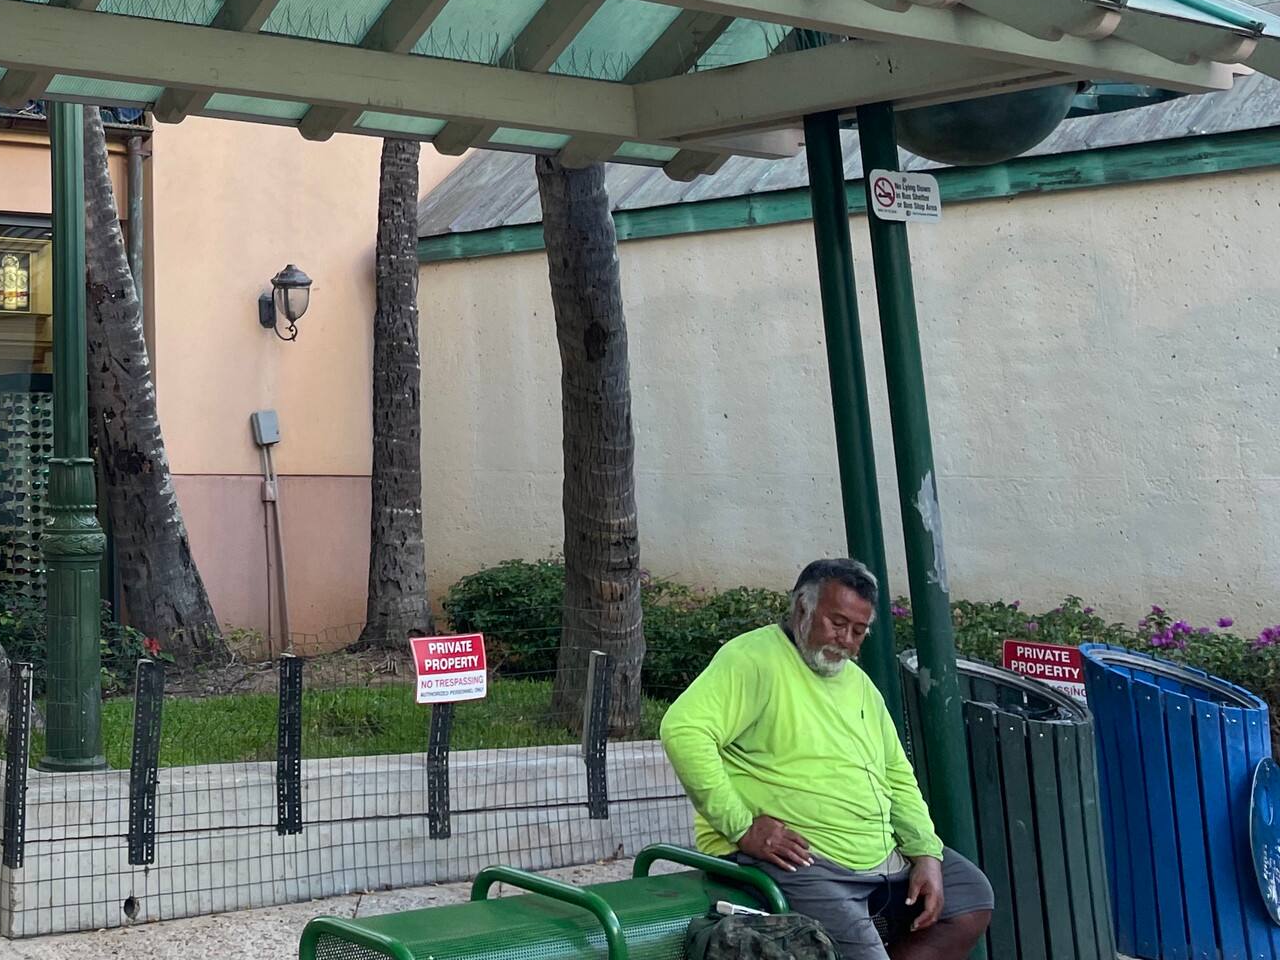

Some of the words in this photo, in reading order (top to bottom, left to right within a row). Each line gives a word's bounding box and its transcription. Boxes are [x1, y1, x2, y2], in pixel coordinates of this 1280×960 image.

[428, 640, 473, 655] PRIVATE
[1016, 645, 1071, 663] PRIVATE
[424, 655, 479, 672] PROPERTY
[1010, 659, 1080, 679] PROPERTY
[420, 679, 433, 689] NO
[435, 675, 483, 687] TRESPASSING
